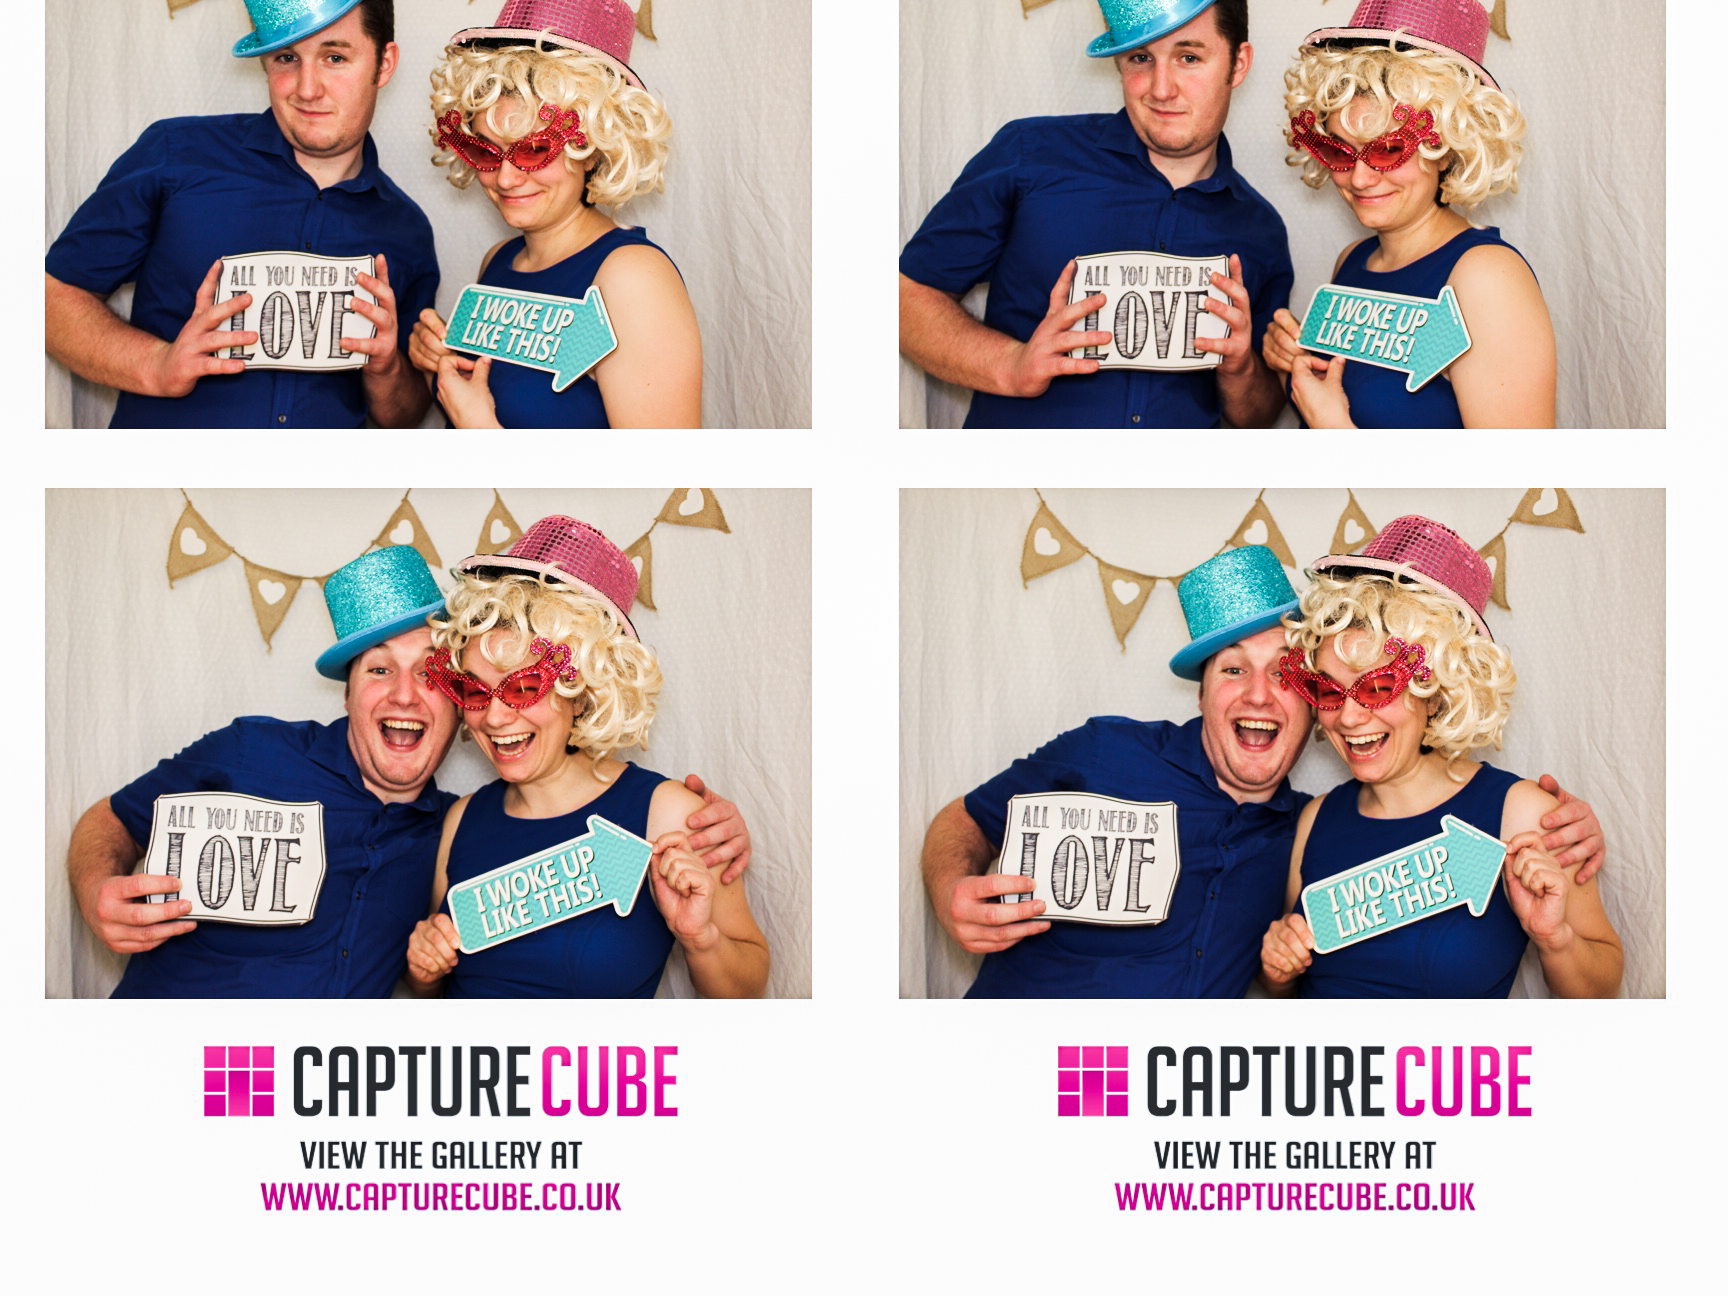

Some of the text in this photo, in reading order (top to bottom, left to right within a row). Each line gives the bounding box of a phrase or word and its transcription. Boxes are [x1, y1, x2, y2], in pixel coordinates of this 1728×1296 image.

[230, 265, 359, 287] ALL YOU NEED IS
[1084, 265, 1213, 287] ALL YOU NEED IS
[229, 290, 355, 361] LOVE
[470, 295, 574, 336] I WOKE UP
[1083, 290, 1209, 361] LOVE
[1324, 295, 1428, 336] I WOKE UP
[461, 320, 562, 364] LIKE THIS!
[1315, 320, 1416, 364] LIKE THIS!
[167, 804, 305, 834] ALL YOU NEED IS
[1021, 804, 1159, 834] ALL YOU NEED IS
[473, 845, 595, 914] I WOKE UP
[1327, 845, 1449, 914] I WOKE UP
[480, 872, 603, 939] LIKE THIS!
[1334, 872, 1457, 939] LIKE THIS!
